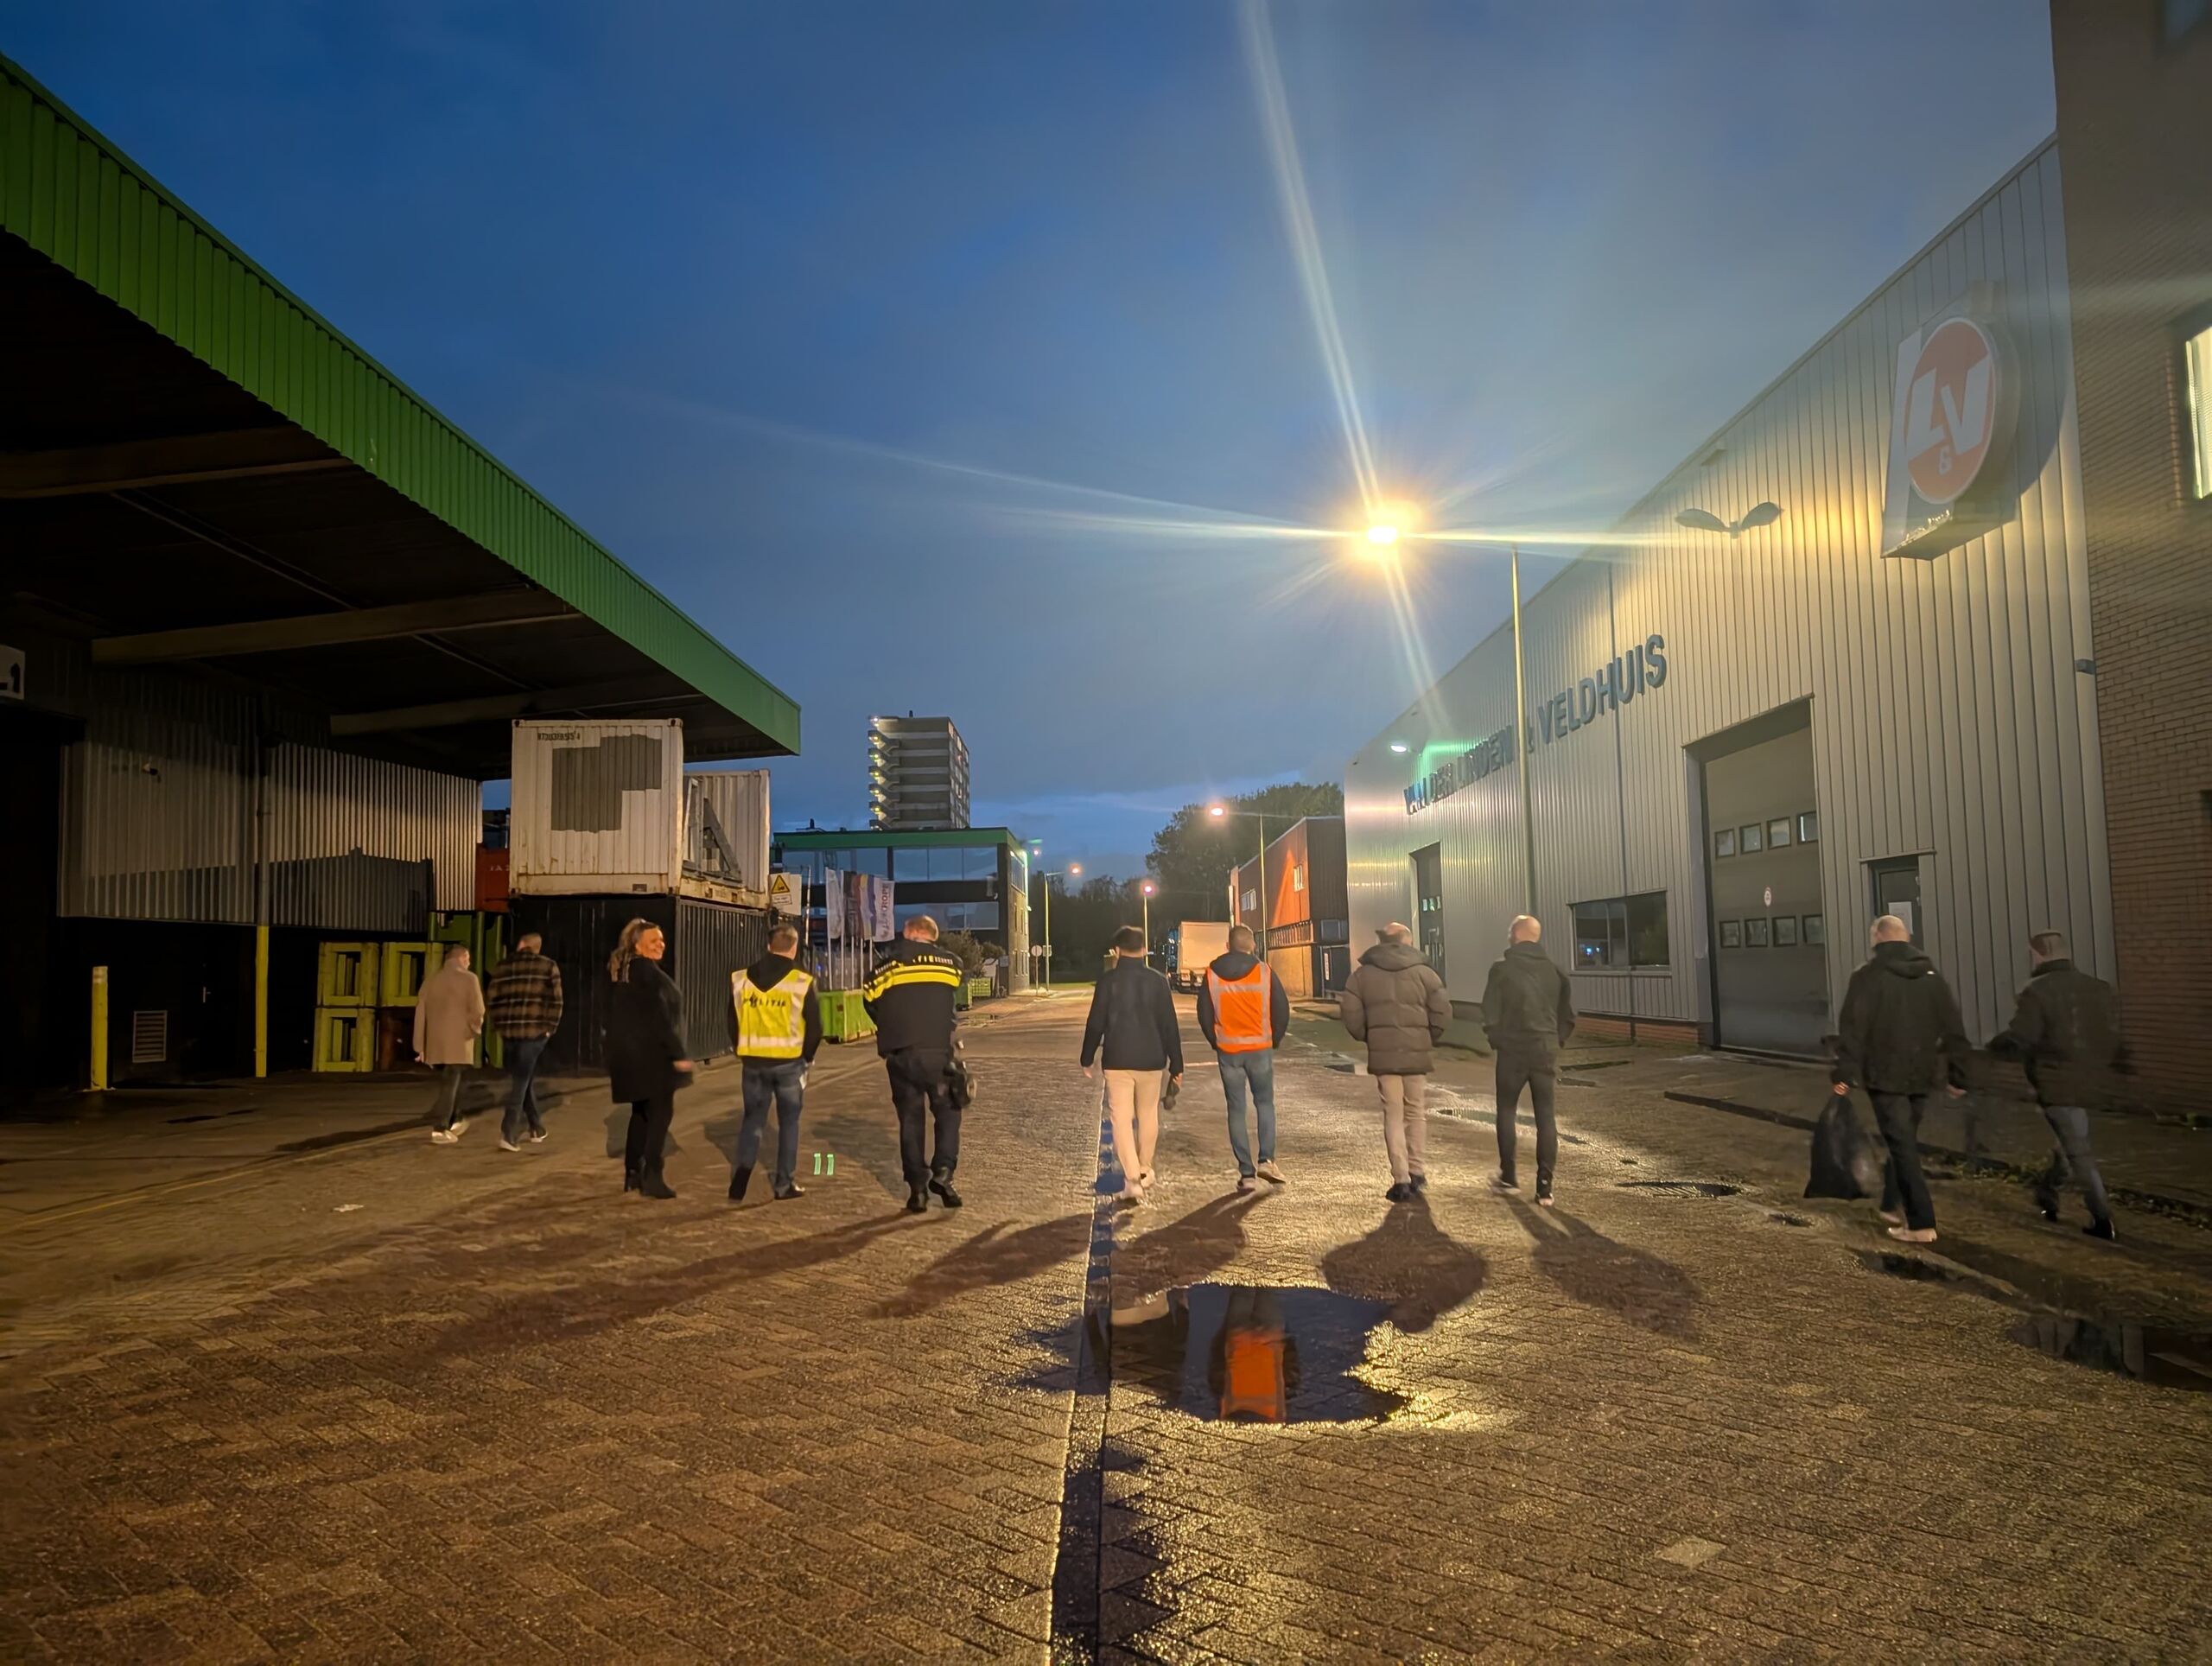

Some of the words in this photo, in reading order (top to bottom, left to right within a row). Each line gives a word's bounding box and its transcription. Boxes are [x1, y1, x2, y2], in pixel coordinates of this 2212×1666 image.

[1403, 778, 1430, 816] VAN
[1429, 763, 1456, 803] DER
[1458, 725, 1515, 788] LINDEN
[1538, 634, 1668, 745] VELDHUIS
